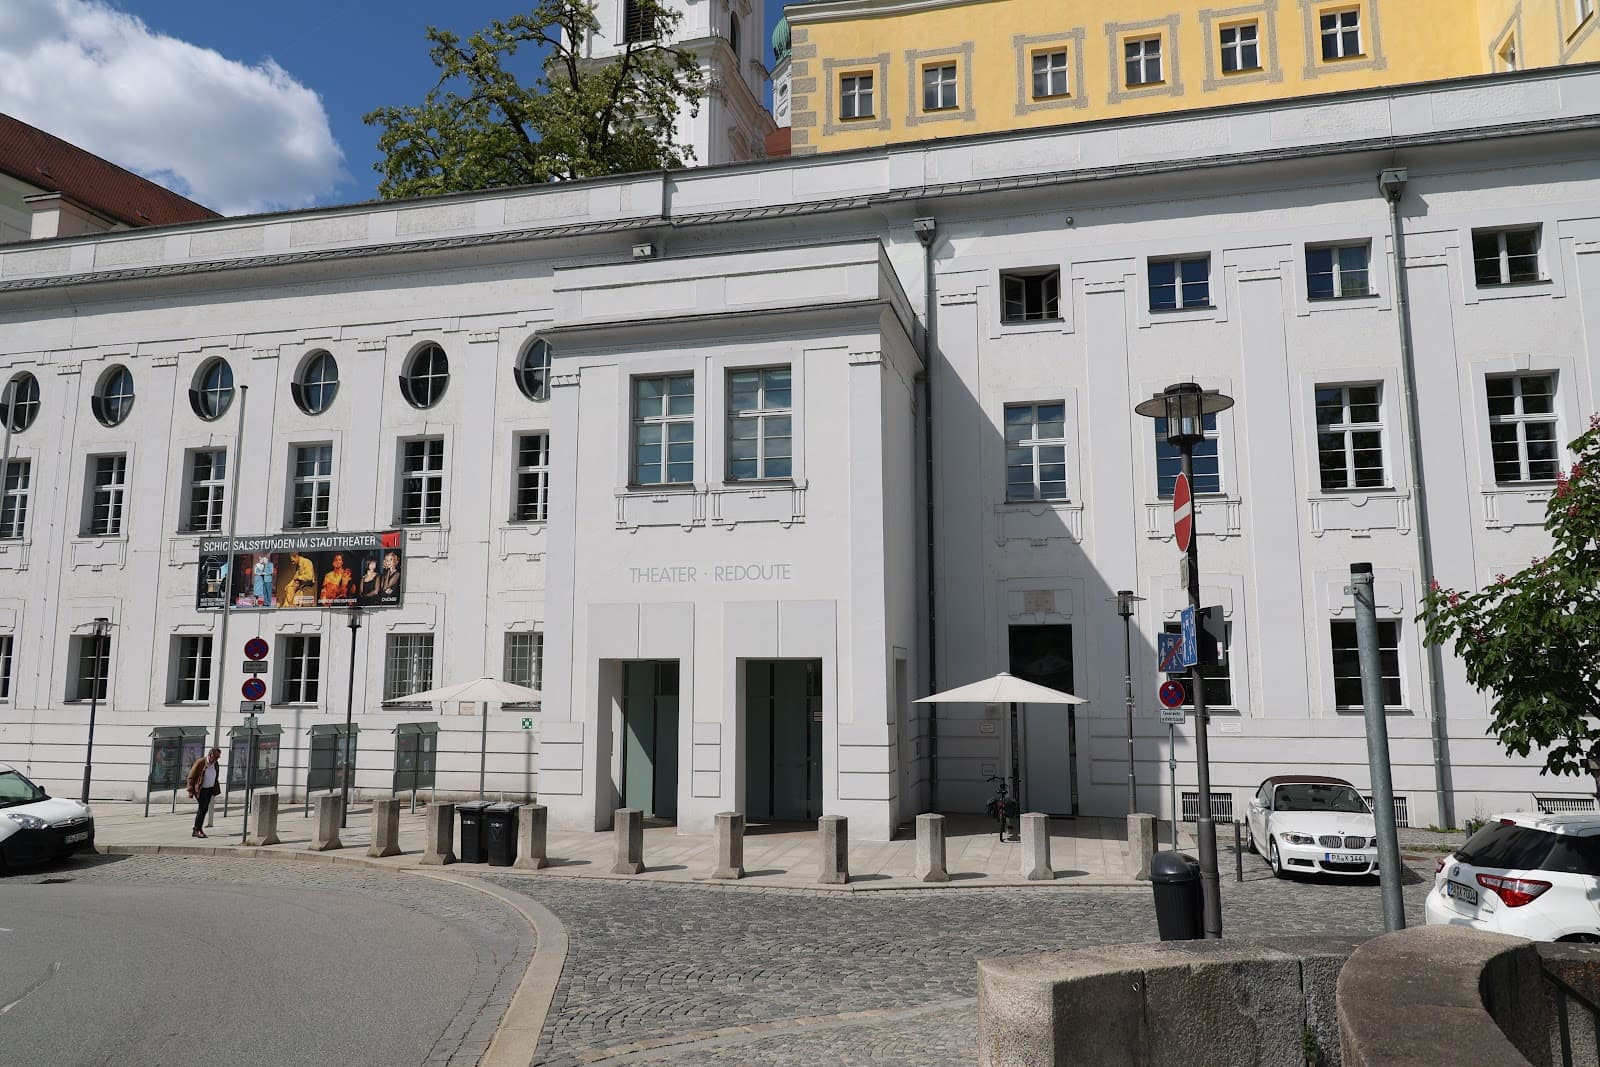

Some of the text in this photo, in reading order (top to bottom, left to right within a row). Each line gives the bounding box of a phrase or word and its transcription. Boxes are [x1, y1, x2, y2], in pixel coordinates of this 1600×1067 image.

[296, 537, 308, 548] IM
[310, 535, 376, 548] STADTTHEATER
[629, 566, 697, 584] THEATER
[714, 563, 792, 582] REDOUTE
